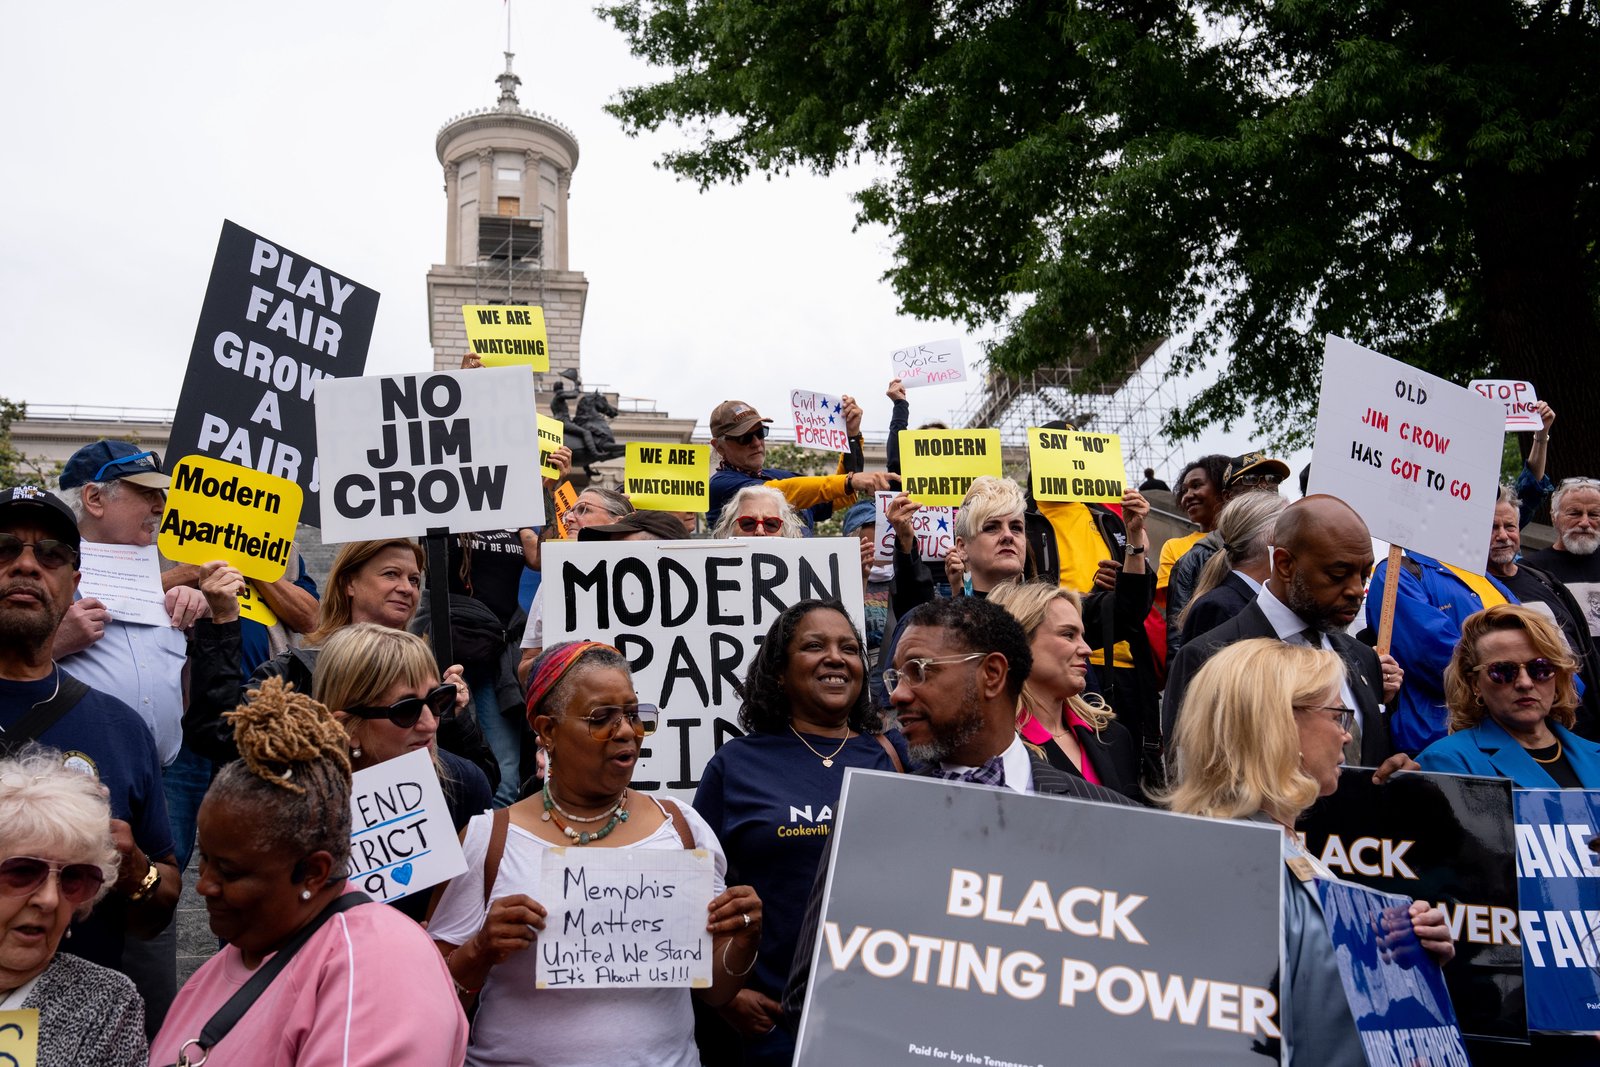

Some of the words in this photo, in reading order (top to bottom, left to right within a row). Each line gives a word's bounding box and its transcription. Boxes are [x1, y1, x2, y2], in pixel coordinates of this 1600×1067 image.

[250, 238, 355, 315] PLAY
[246, 285, 343, 357] FAIR
[477, 310, 501, 325] WE
[506, 310, 532, 325] ARE
[472, 339, 545, 356] WATCHING
[893, 345, 934, 362] OUR
[898, 367, 928, 378] OUR
[905, 353, 951, 368] VOICE
[380, 374, 462, 422] NO
[792, 391, 815, 411] Civil
[1395, 380, 1427, 405] OLD
[1475, 383, 1527, 401] STOP
[250, 390, 282, 431] A
[795, 411, 826, 428] Rights
[537, 429, 562, 444] ATTER
[796, 425, 849, 450] FOREVER
[1039, 433, 1068, 450] SAY
[1362, 408, 1389, 432] JIM
[1400, 422, 1450, 454] CROW
[367, 419, 472, 469] JIM
[639, 447, 663, 464] WE
[668, 449, 695, 465] ARE
[914, 438, 986, 456] MODERN
[1072, 460, 1085, 470] TO
[1351, 441, 1382, 468] HAS
[1391, 457, 1421, 482] GOT
[1427, 469, 1445, 491] TO
[1450, 479, 1471, 501] GO
[175, 464, 281, 514] Modern
[334, 465, 508, 519] CROW
[629, 478, 705, 497] WATCHING
[906, 477, 972, 495] APARTH
[1040, 477, 1067, 495] JIM
[1072, 478, 1122, 497] CROW
[160, 508, 291, 567] Apartheid!
[490, 543, 502, 553] BE
[880, 533, 951, 559] STUS
[563, 552, 841, 632] MODERN
[614, 632, 766, 709] PAR
[777, 824, 830, 838] Cookevill
[1297, 832, 1420, 880] ACK
[1514, 823, 1600, 878] AKE
[364, 873, 387, 898] 9
[563, 866, 676, 914] Memphis
[946, 868, 1148, 945] BLACK
[563, 908, 664, 937] Matters
[543, 938, 615, 967] United
[622, 943, 649, 963] We
[655, 938, 702, 962] Stand
[547, 967, 585, 986] It's
[595, 966, 641, 984] About
[823, 921, 1047, 1001] VOTING
[1059, 957, 1282, 1039] POWER
[908, 1043, 931, 1056] Paid
[933, 1047, 948, 1059] for
[950, 1050, 963, 1063] by
[965, 1053, 982, 1064] the
